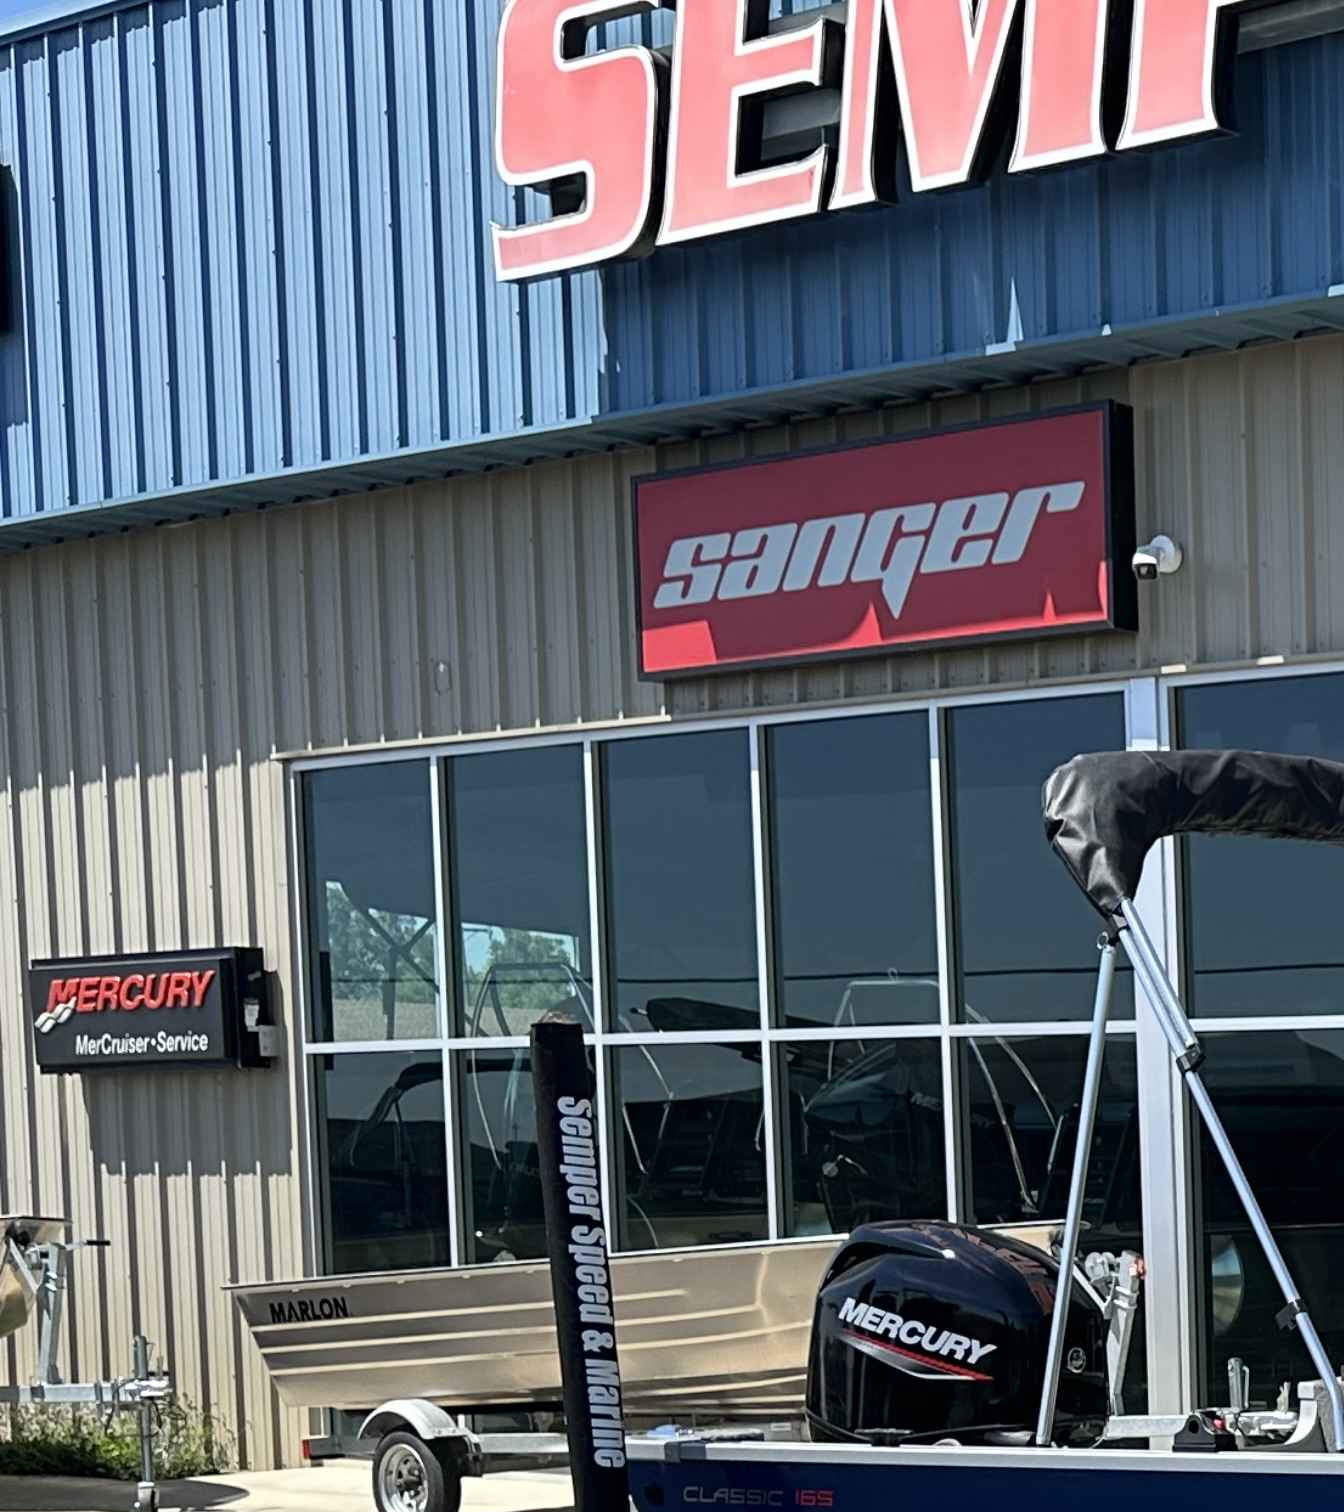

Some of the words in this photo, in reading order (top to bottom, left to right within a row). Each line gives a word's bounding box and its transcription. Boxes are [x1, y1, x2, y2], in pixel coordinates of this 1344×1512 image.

[46, 970, 216, 1014] MERCURY
[569, 1224, 614, 1324] Speed
[269, 1296, 349, 1324] MARLON
[838, 1297, 998, 1366] MERCURY
[581, 1331, 614, 1353] &
[584, 1358, 626, 1469] Marine
[683, 1486, 784, 1506] CLASSIC
[795, 1488, 833, 1507] 165
